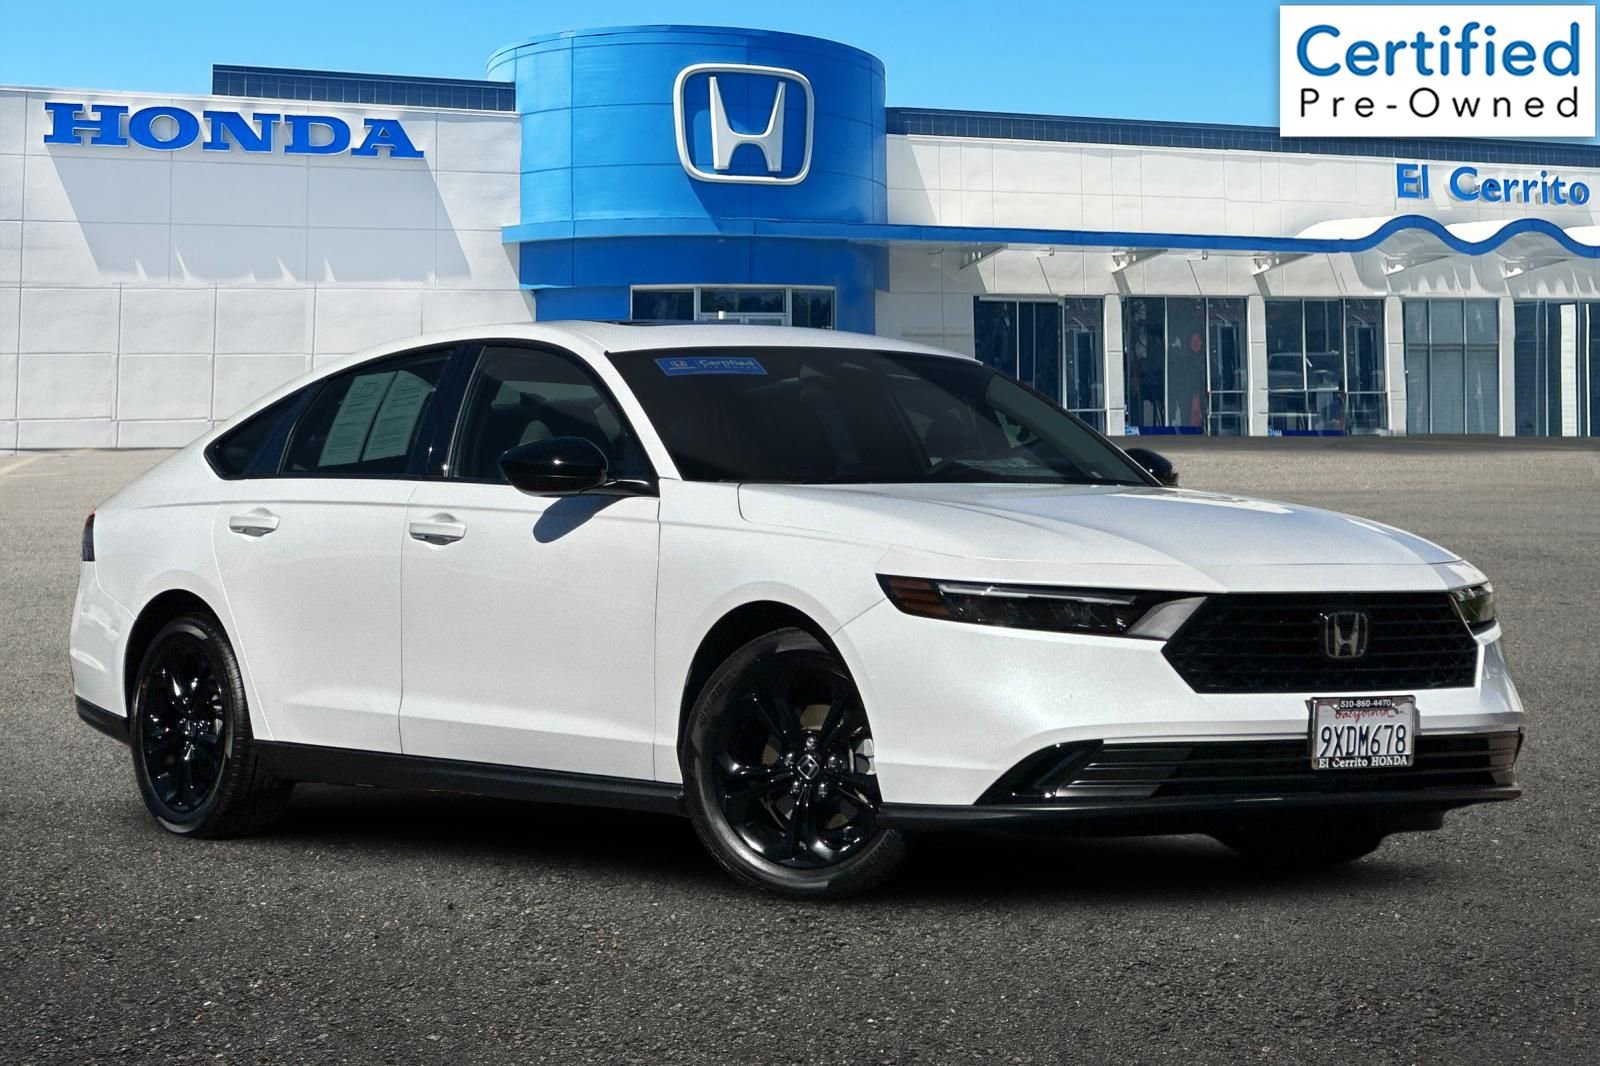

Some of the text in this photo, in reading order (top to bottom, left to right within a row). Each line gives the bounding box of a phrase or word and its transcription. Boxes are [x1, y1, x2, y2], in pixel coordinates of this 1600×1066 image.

[43, 101, 425, 158] HONDA
[1396, 163, 1590, 205] El Cerrito
[1320, 724, 1406, 757] 9XDM678
[1318, 755, 1408, 768] El Cerrito HONDA
